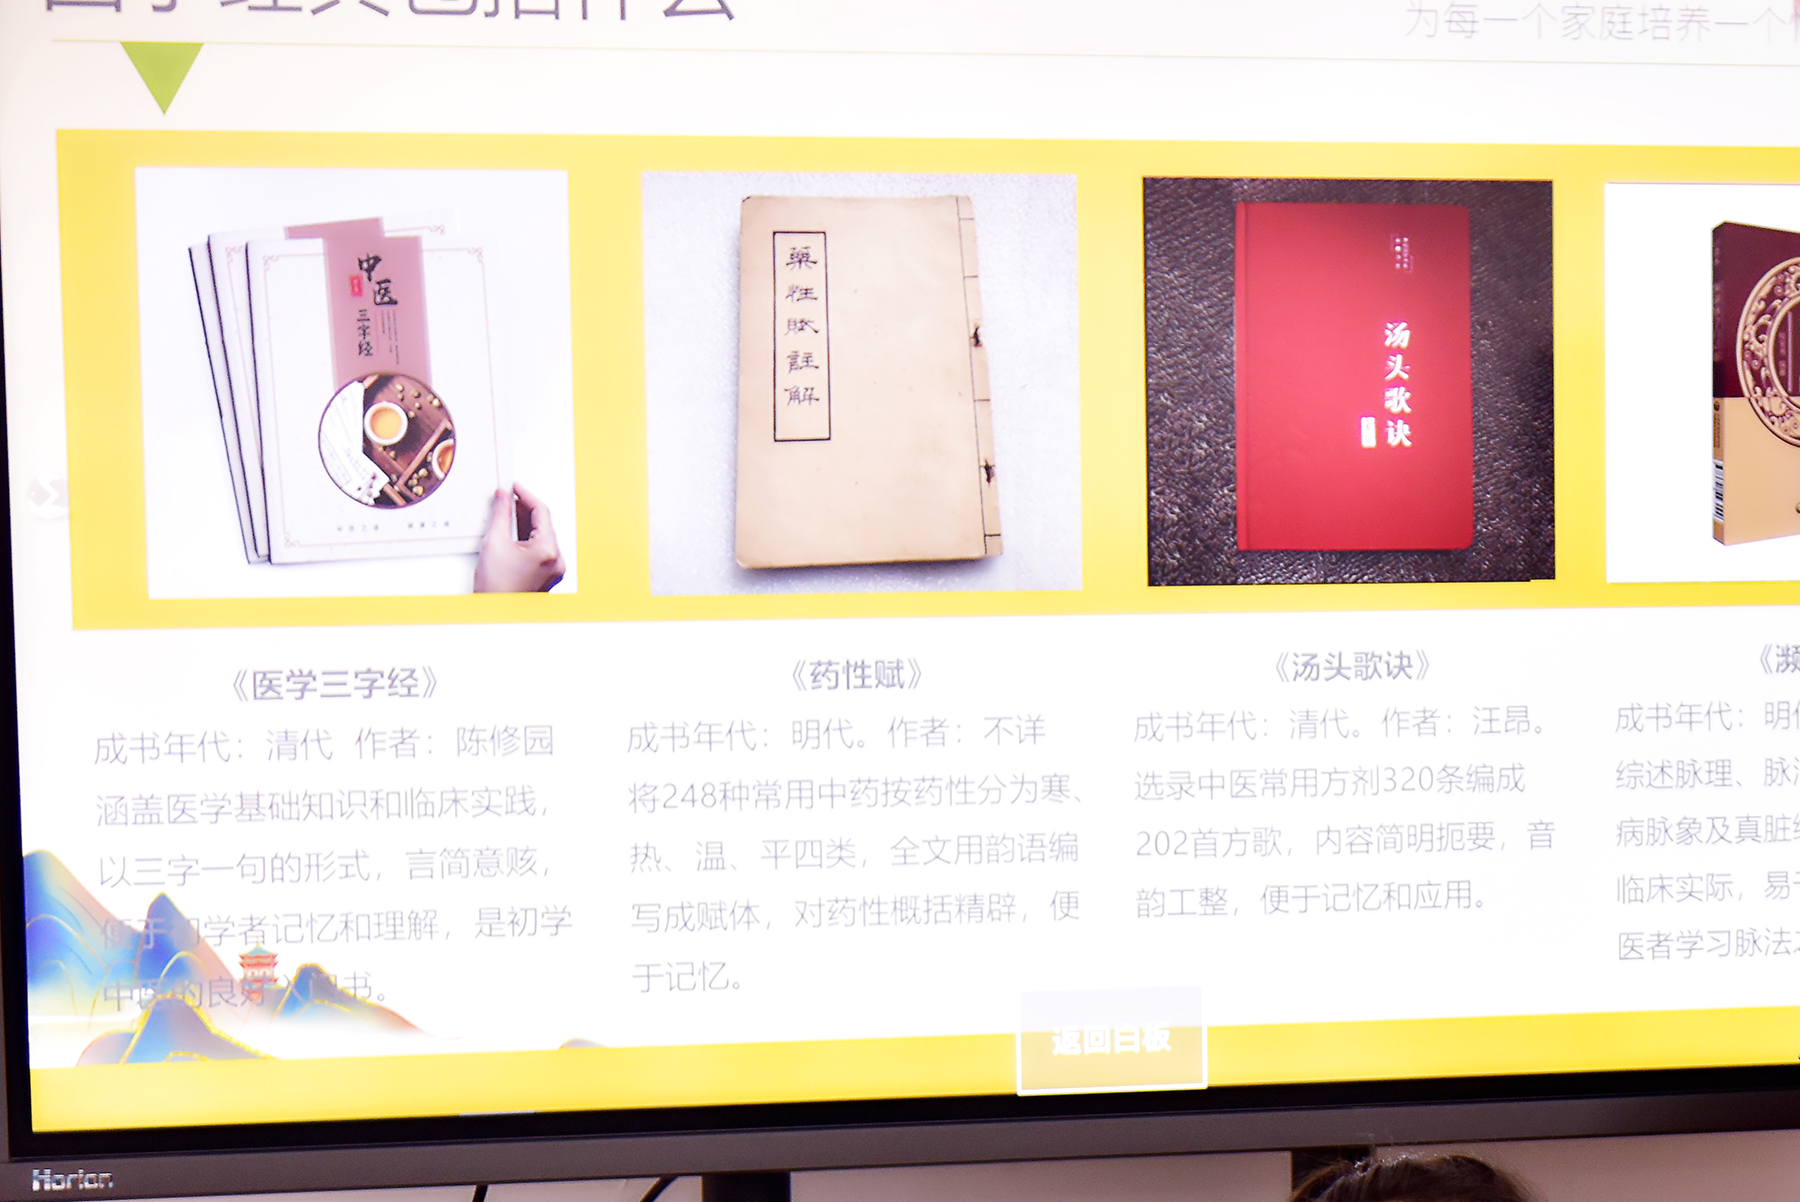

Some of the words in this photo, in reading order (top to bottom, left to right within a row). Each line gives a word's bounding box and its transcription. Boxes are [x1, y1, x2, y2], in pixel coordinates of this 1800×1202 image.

[357, 252, 399, 306] 中医
[357, 309, 373, 357] 三字经
[1384, 321, 1413, 447] 汤头歌诀
[232, 666, 438, 702] 《医学三字经》
[792, 657, 922, 691] 《药性赋》
[1275, 649, 1430, 683] 《汤头歌诀》
[628, 772, 1081, 814] 将248种常用中药按药性分为寒、
[1134, 761, 1526, 801] 选录中医常用方剂320条编成
[96, 784, 547, 827] 涵盖医学基础知识和临床实践，
[1135, 879, 1484, 919] 韵工整，便于记忆和应用。
[632, 960, 741, 993] 于记忆。
[1052, 1021, 1171, 1056] 返回白板
[32, 1168, 114, 1191] Horion
